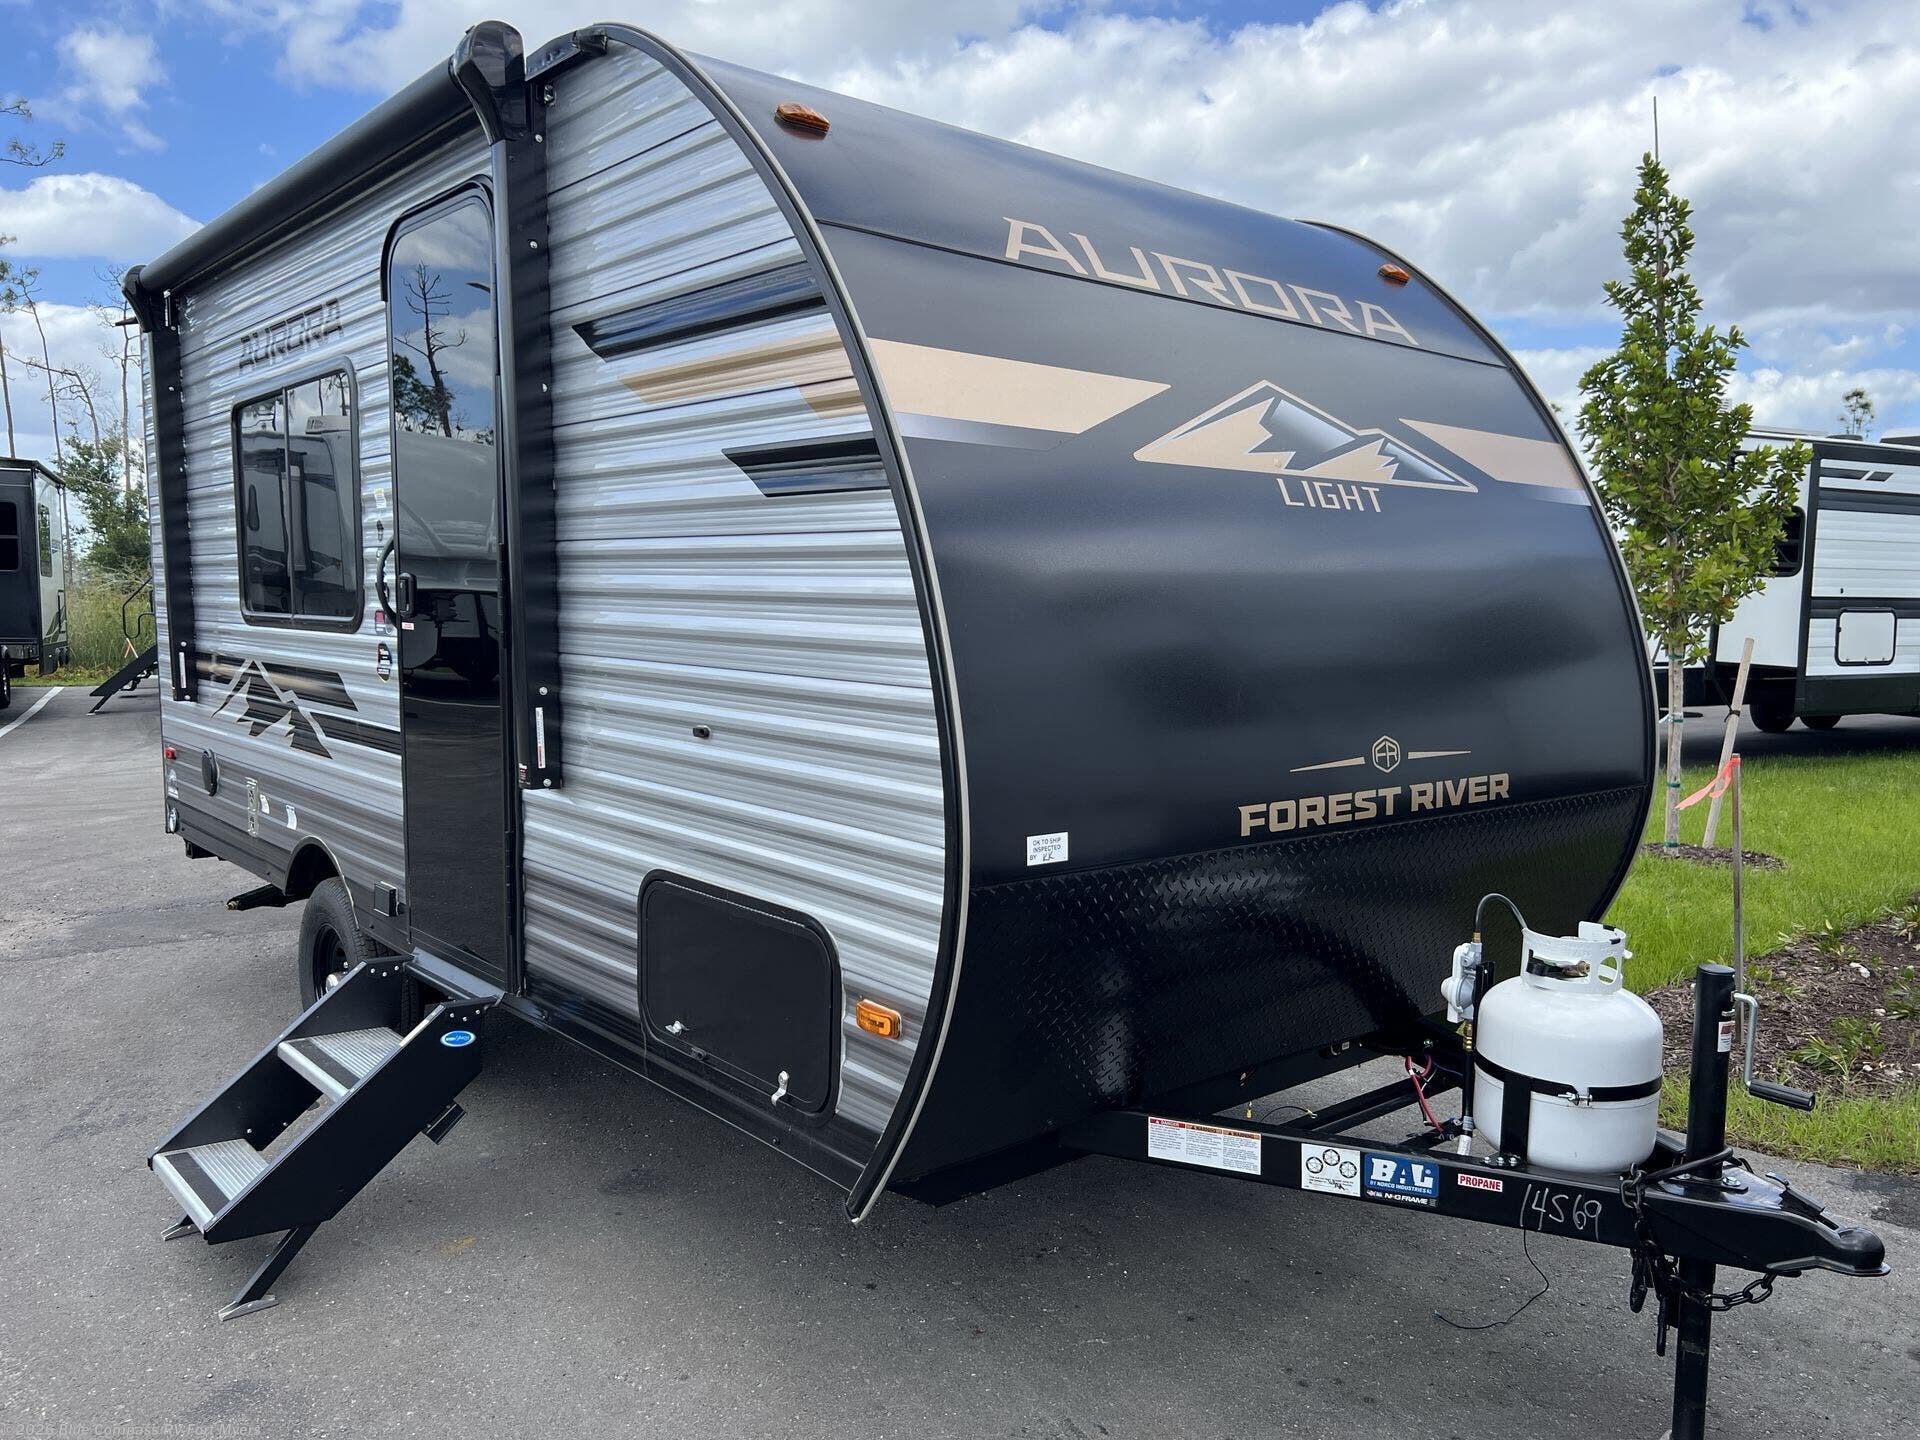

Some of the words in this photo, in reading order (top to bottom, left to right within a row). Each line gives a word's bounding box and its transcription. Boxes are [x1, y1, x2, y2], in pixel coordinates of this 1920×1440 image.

[1002, 216, 1420, 346] AURORA
[239, 298, 344, 369] AURORA
[1276, 478, 1381, 513] LIGHT
[1238, 786, 1402, 837] FOREST
[1409, 772, 1511, 812] RIVER
[1032, 844, 1062, 853] INSPECTED
[1370, 1157, 1434, 1189] BAL
[1377, 1181, 1395, 1189] NORCO
[1395, 1183, 1427, 1194] INDUSTRIES
[1459, 1175, 1501, 1191] PROPANE
[1401, 1194, 1429, 1205] FRAME
[1519, 1183, 1602, 1243] 14569
